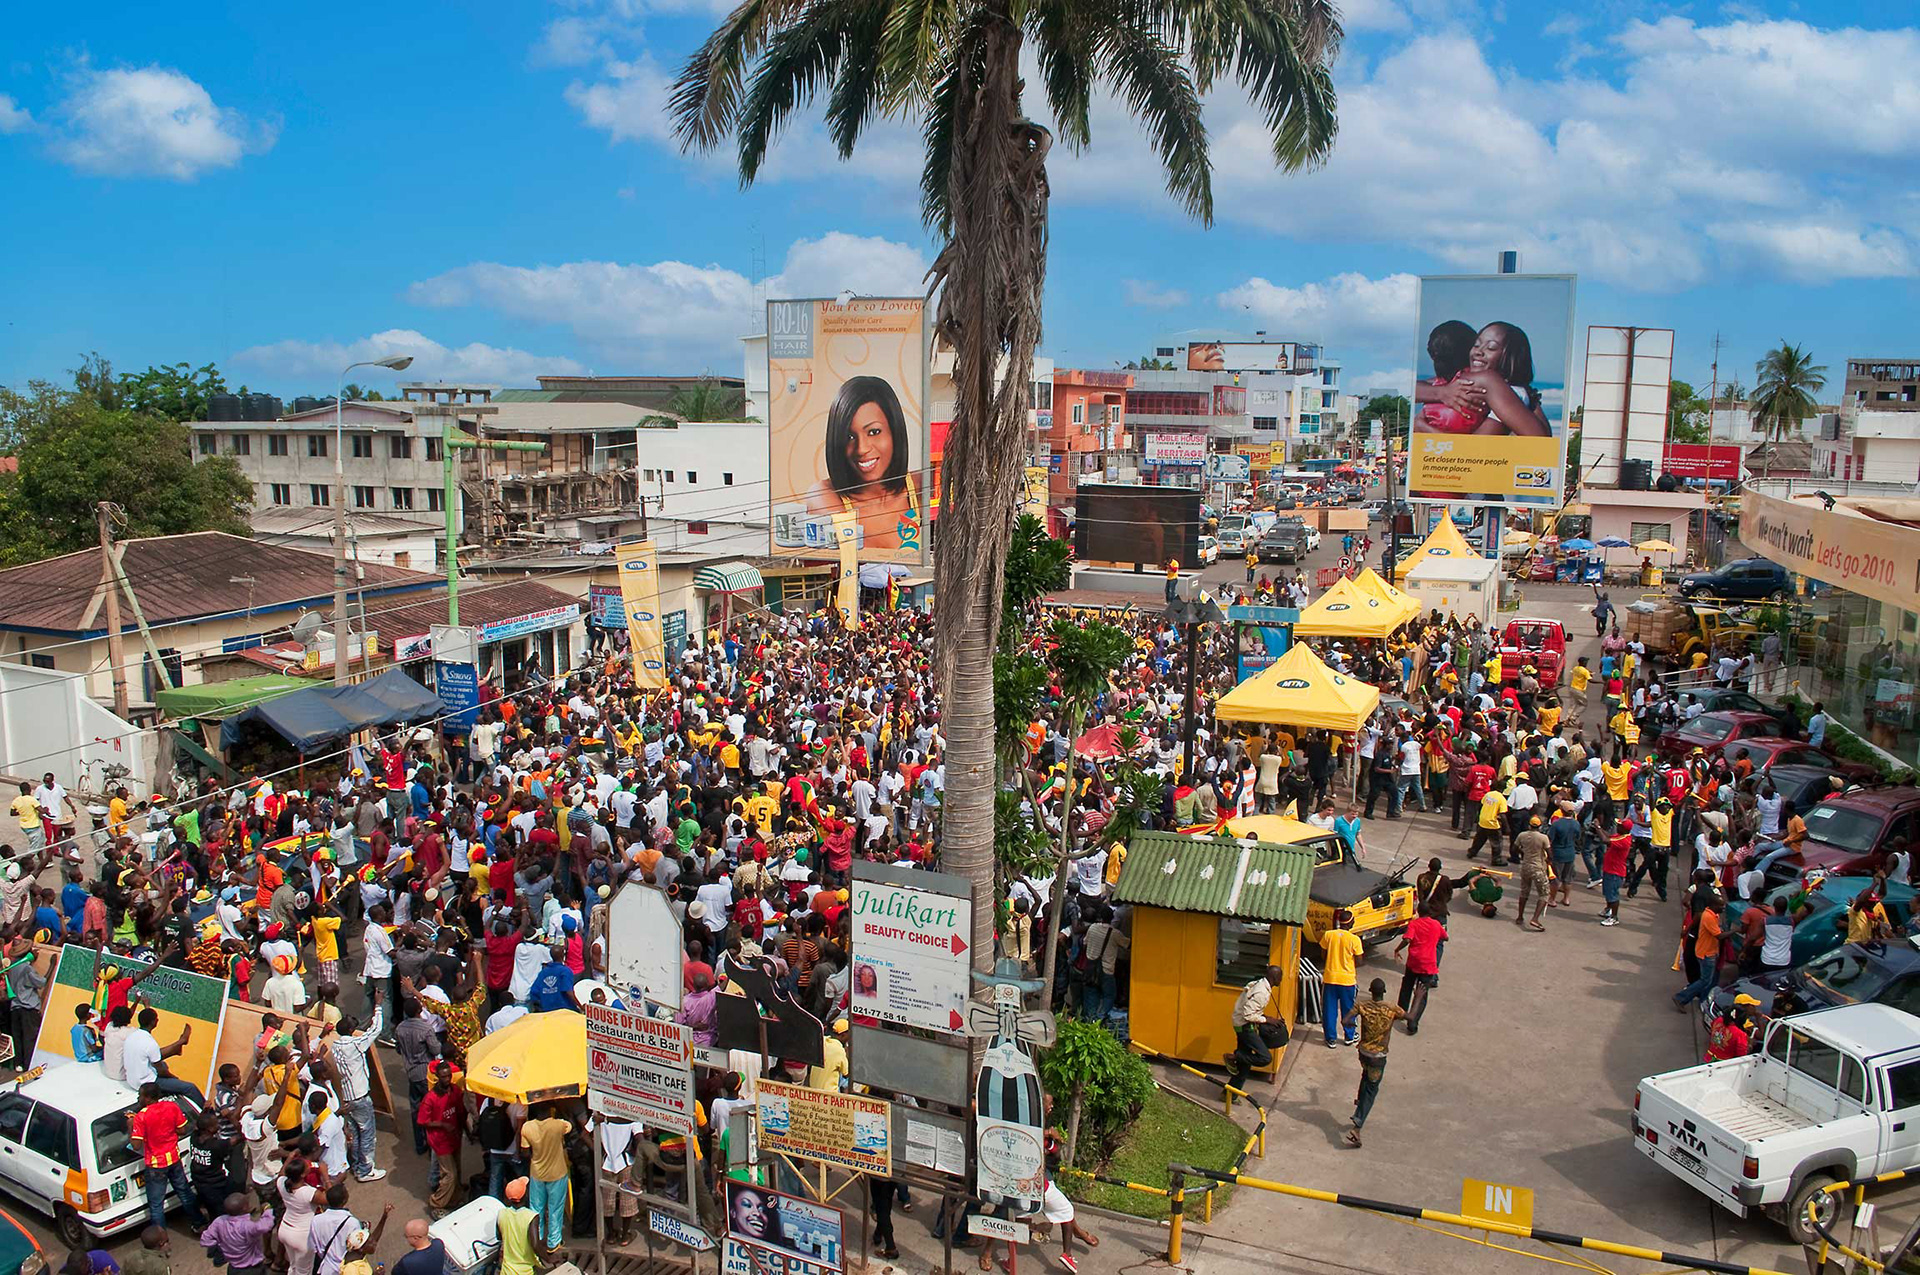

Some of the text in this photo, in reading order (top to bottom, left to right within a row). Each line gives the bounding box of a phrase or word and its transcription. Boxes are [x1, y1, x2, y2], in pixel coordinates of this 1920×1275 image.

[821, 300, 922, 315] Youre so Lovely
[773, 341, 808, 350] HAIR
[1155, 435, 1205, 443] NOBLE HOUSE
[1156, 449, 1203, 457] HERITAGE
[1423, 455, 1436, 463] Get
[1436, 456, 1456, 464] closer
[1484, 458, 1509, 467] people
[1449, 466, 1472, 474] places.
[1758, 515, 1768, 541] We
[1768, 522, 1788, 550] can't
[1788, 529, 1815, 561] wait.
[1817, 541, 1842, 570] Let's
[1842, 555, 1859, 579] go
[1861, 553, 1896, 587] 2010.
[486, 607, 566, 629] HILARIOUS SERVICES
[1281, 680, 1305, 688] MTN
[113, 737, 122, 752] IN
[1673, 775, 1684, 787] 10
[758, 807, 768, 822] 5
[173, 872, 184, 883] 19
[853, 890, 956, 928] Julikart
[864, 923, 948, 948] BEAUTY CHOICE
[855, 955, 895, 968] Dealers in:
[160, 972, 192, 993] Move
[586, 1004, 680, 1040] HOUSE OF OVATION
[853, 1005, 881, 1018] 021-77
[883, 1010, 894, 1021] 58
[896, 1013, 907, 1023] 16
[587, 1020, 679, 1051] Restaurant & Bar
[693, 1049, 710, 1061] LANE
[621, 1064, 662, 1084] INTERNET
[664, 1074, 687, 1091] CAFÉ
[789, 1089, 823, 1104] GALLERY
[831, 1096, 857, 1111] PARTY
[860, 1101, 885, 1116] PLACE
[602, 1096, 617, 1107] GHANA
[618, 1100, 630, 1110] RURAL
[655, 1110, 660, 1119] &
[660, 1111, 674, 1123] TRAVEL
[674, 1115, 689, 1128] OFFICE
[1667, 1120, 1708, 1157] TATA
[829, 1146, 838, 1155] OFF
[858, 1152, 876, 1163] STREET
[1670, 1148, 1680, 1161] GE
[1680, 1152, 1696, 1169] 3967
[1485, 1185, 1512, 1214] IN
[651, 1212, 682, 1230] NETAB
[981, 1218, 1016, 1233] BACCHUS
[652, 1221, 702, 1248] PHARMACY
